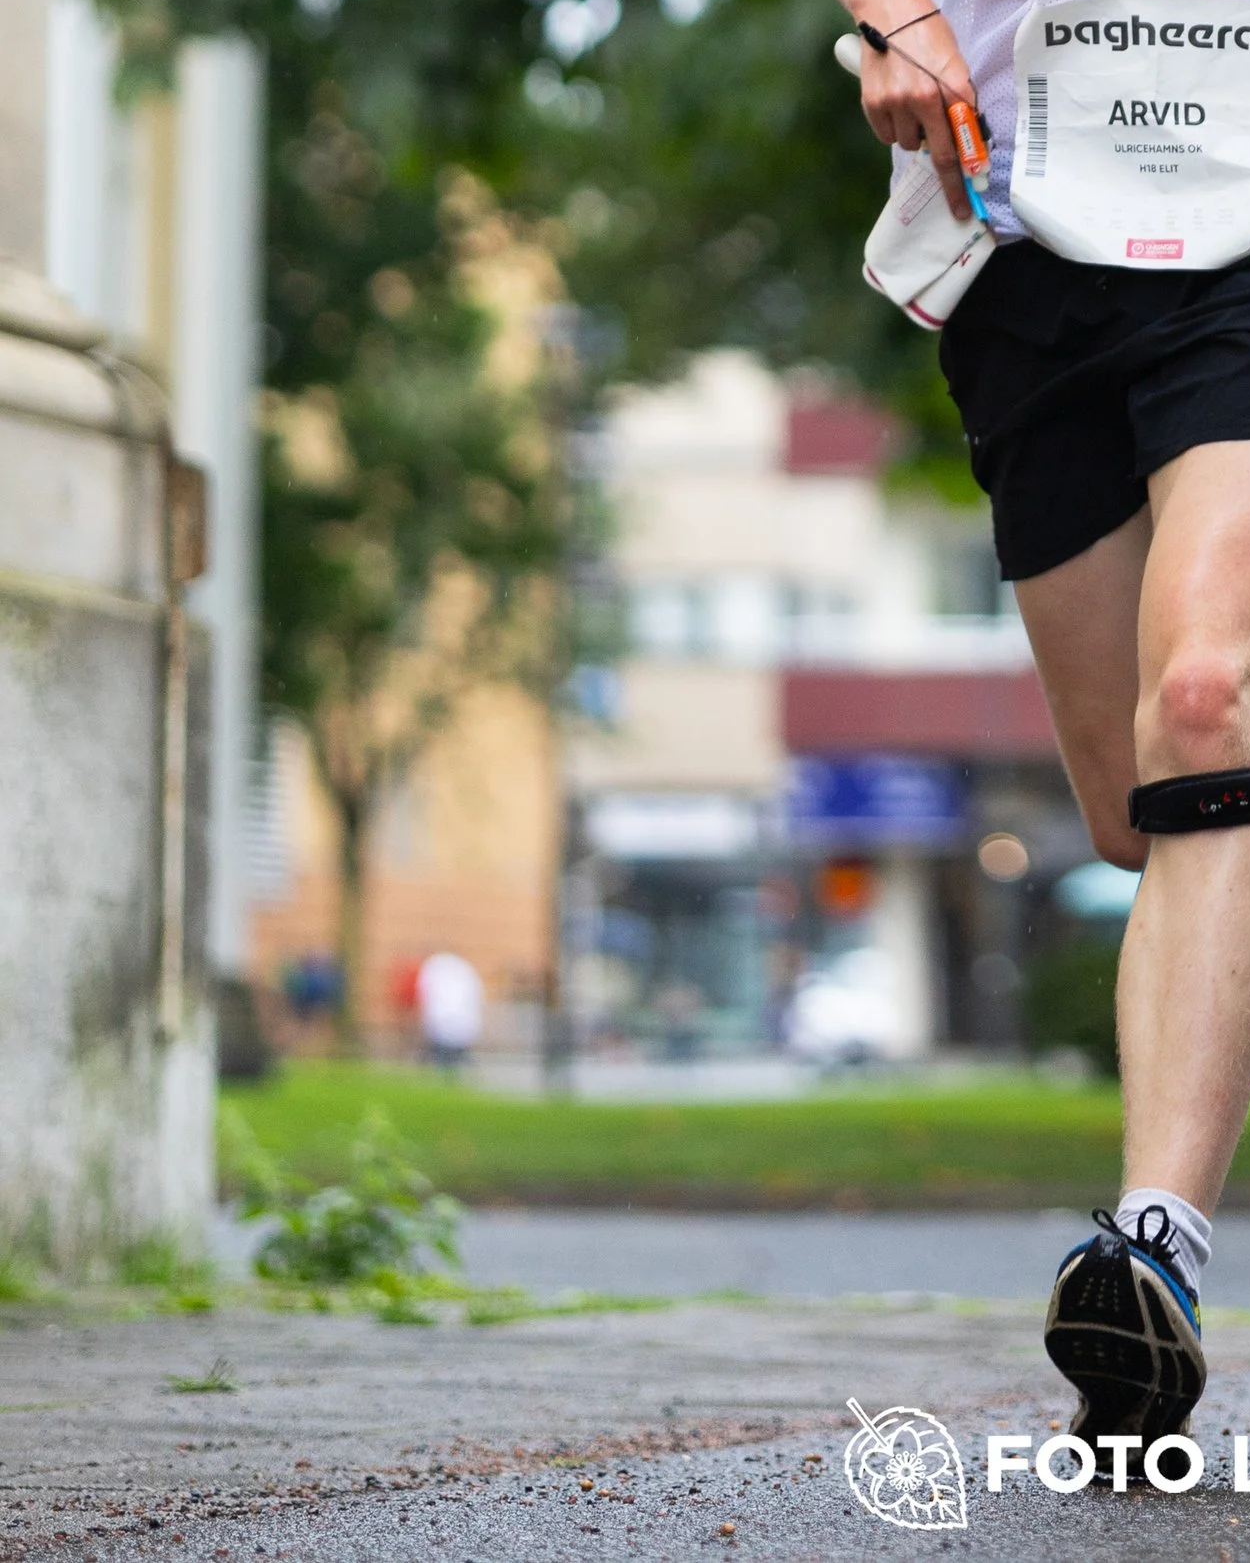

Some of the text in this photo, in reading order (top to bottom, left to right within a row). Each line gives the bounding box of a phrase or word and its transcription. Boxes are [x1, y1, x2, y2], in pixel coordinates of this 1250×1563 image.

[1108, 99, 1206, 126] ARVID
[1114, 143, 1203, 154] ULRICEHAMNS OK
[1139, 164, 1179, 173] H18 ELIT
